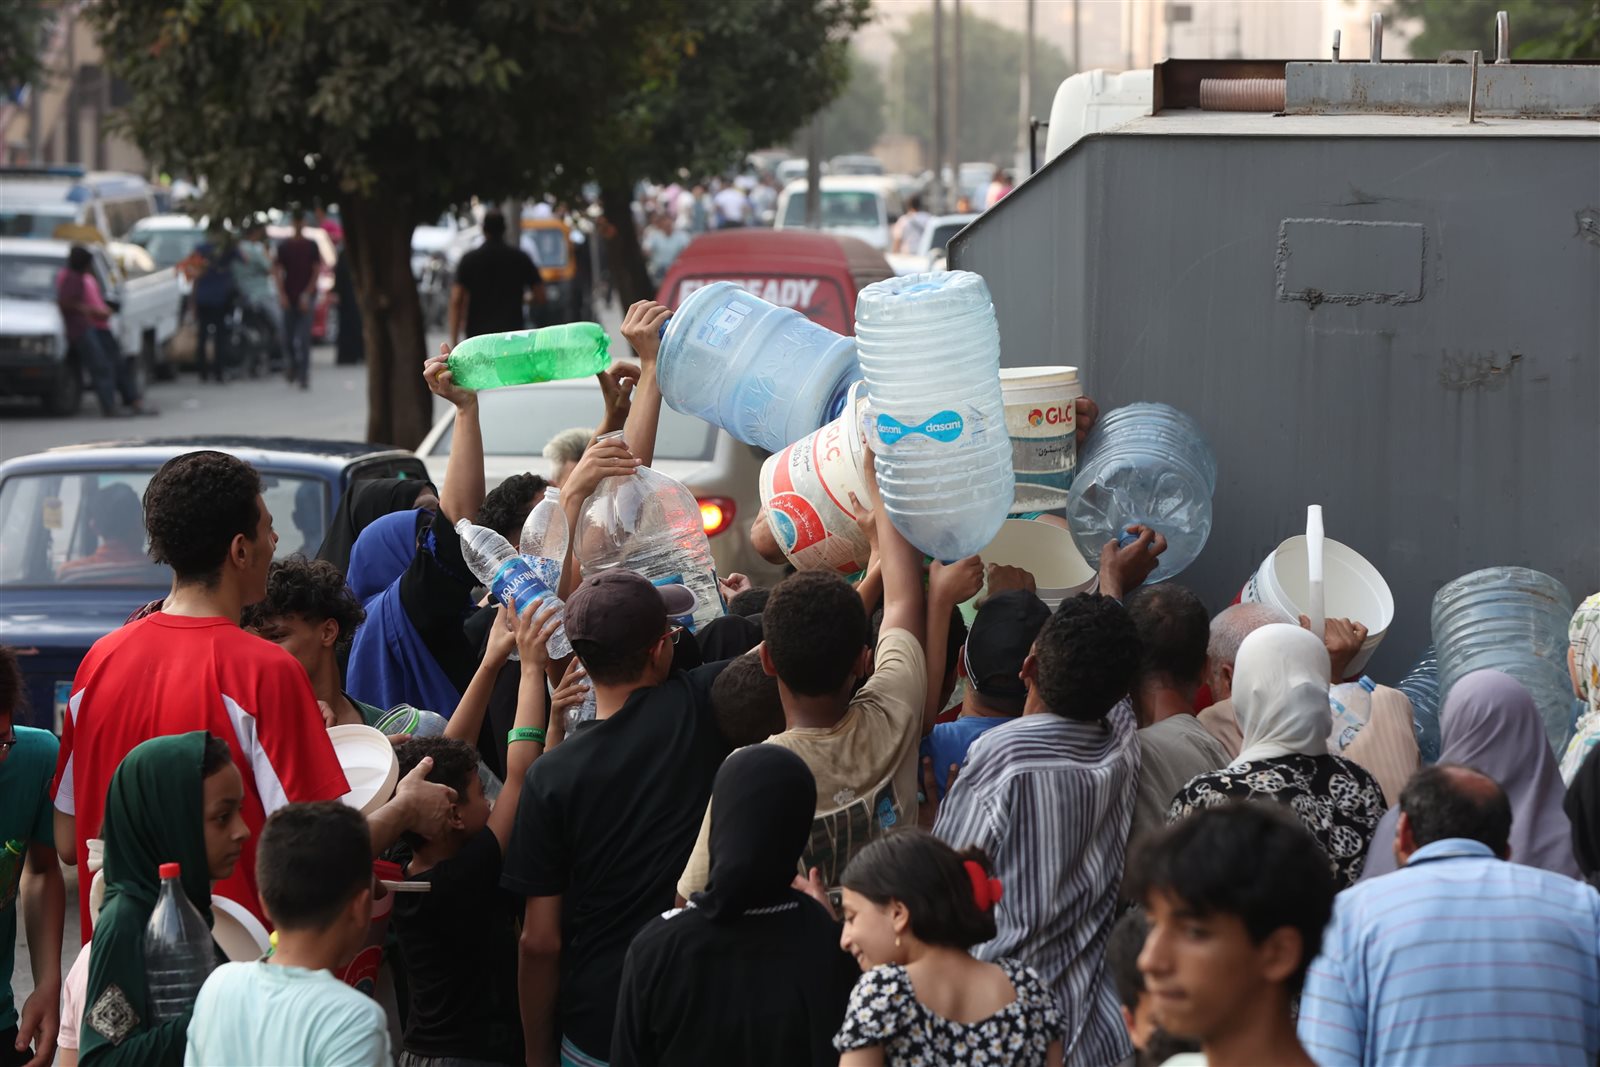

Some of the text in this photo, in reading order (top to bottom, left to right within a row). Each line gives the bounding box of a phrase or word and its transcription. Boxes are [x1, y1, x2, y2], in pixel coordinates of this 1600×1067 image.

[925, 421, 961, 433] dasani
[1045, 404, 1073, 425] GLC
[826, 426, 840, 461] GLC
[500, 570, 537, 605] AQUAFINA
